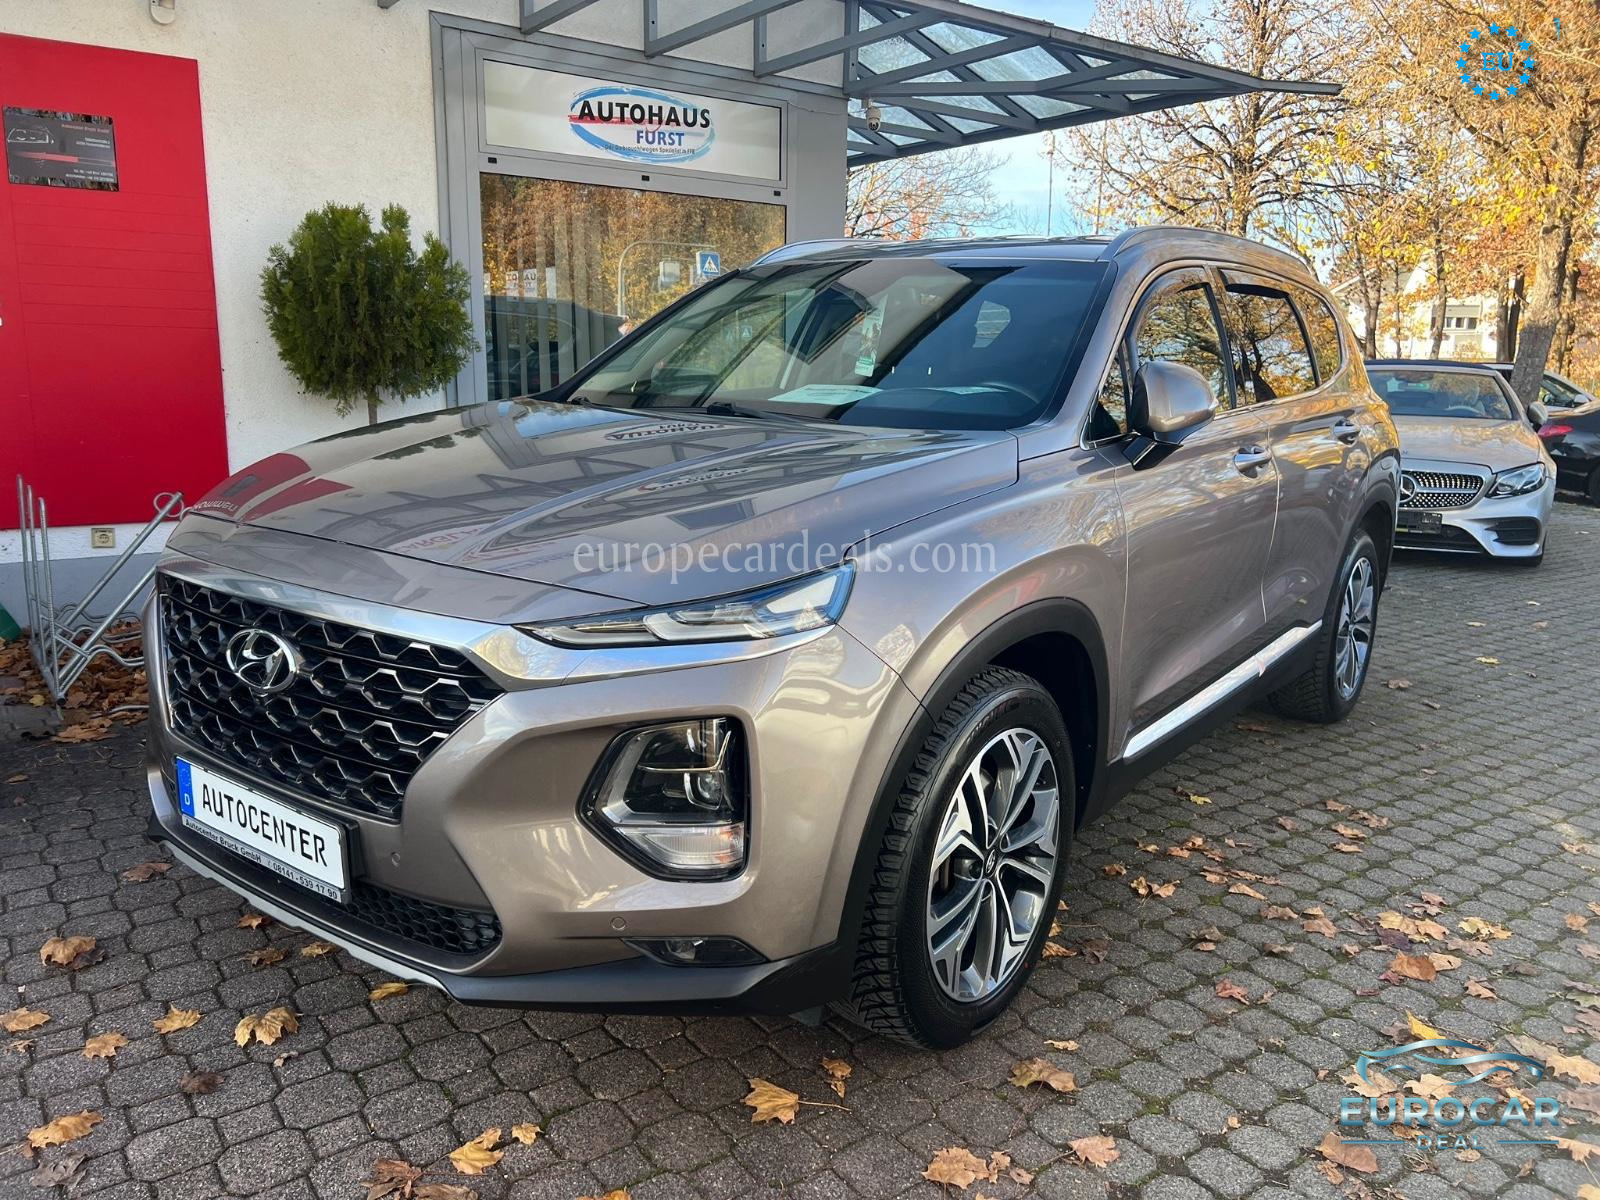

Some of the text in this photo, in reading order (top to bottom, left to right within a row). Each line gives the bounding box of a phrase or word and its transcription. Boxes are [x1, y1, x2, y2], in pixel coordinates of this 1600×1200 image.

[578, 100, 711, 128] AUTOHAUS
[185, 818, 218, 841] Autocenter
[220, 837, 239, 852] Bruck
[240, 847, 262, 863] GmbH
[273, 862, 294, 880] 08141
[300, 876, 314, 889] 539
[316, 883, 325, 894] 17
[327, 888, 338, 900] 90
[202, 783, 328, 868] AUTOCENTER
